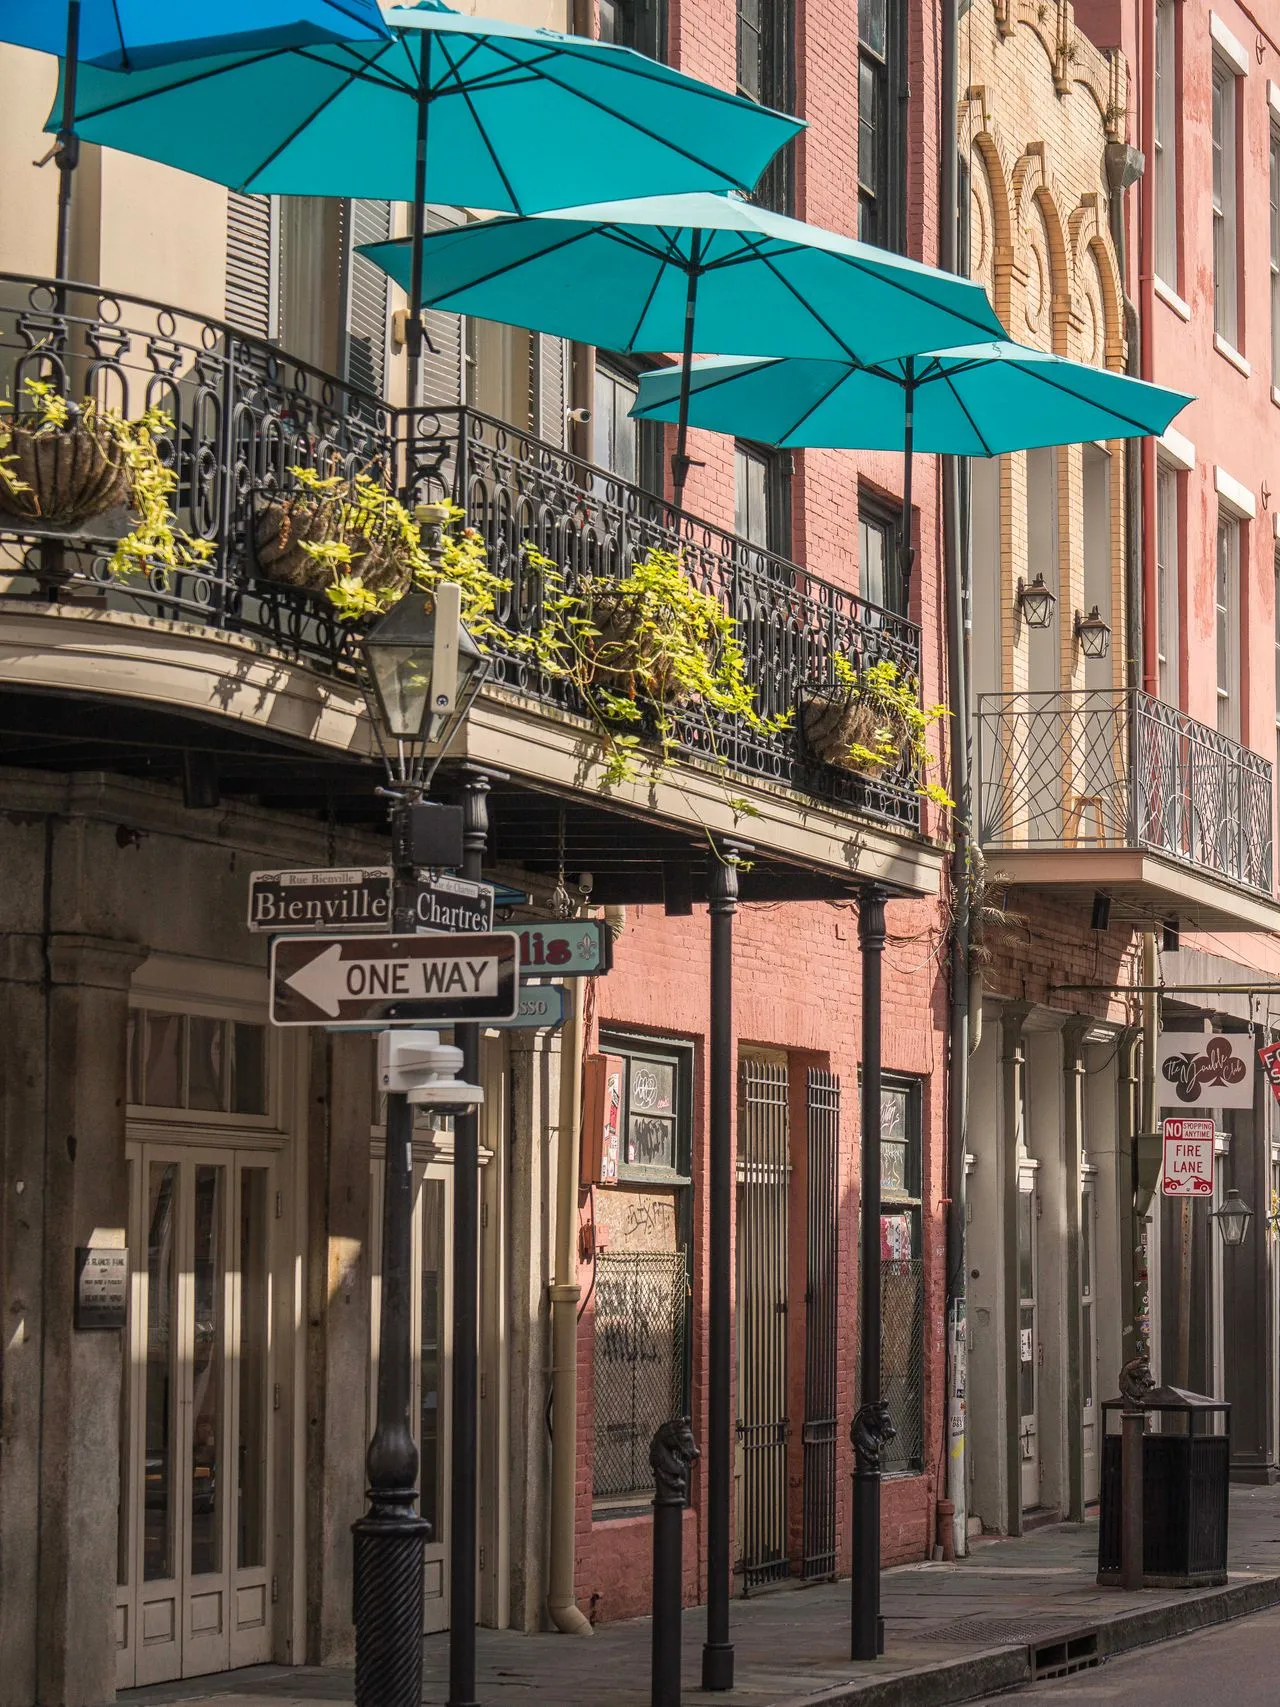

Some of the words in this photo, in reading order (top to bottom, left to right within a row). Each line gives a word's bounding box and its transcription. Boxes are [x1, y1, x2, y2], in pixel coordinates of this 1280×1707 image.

[289, 875, 306, 884] Rue
[311, 873, 354, 883] Bienville
[255, 889, 387, 920] Bienville
[417, 892, 488, 932] Chartres
[346, 963, 410, 995] ONE
[422, 960, 489, 993] WAY
[1165, 1059, 1182, 1080] The
[1222, 1060, 1242, 1080] Club
[1165, 1122, 1182, 1137] NO
[1176, 1145, 1202, 1157] FIRE
[1173, 1161, 1204, 1173] LANE
